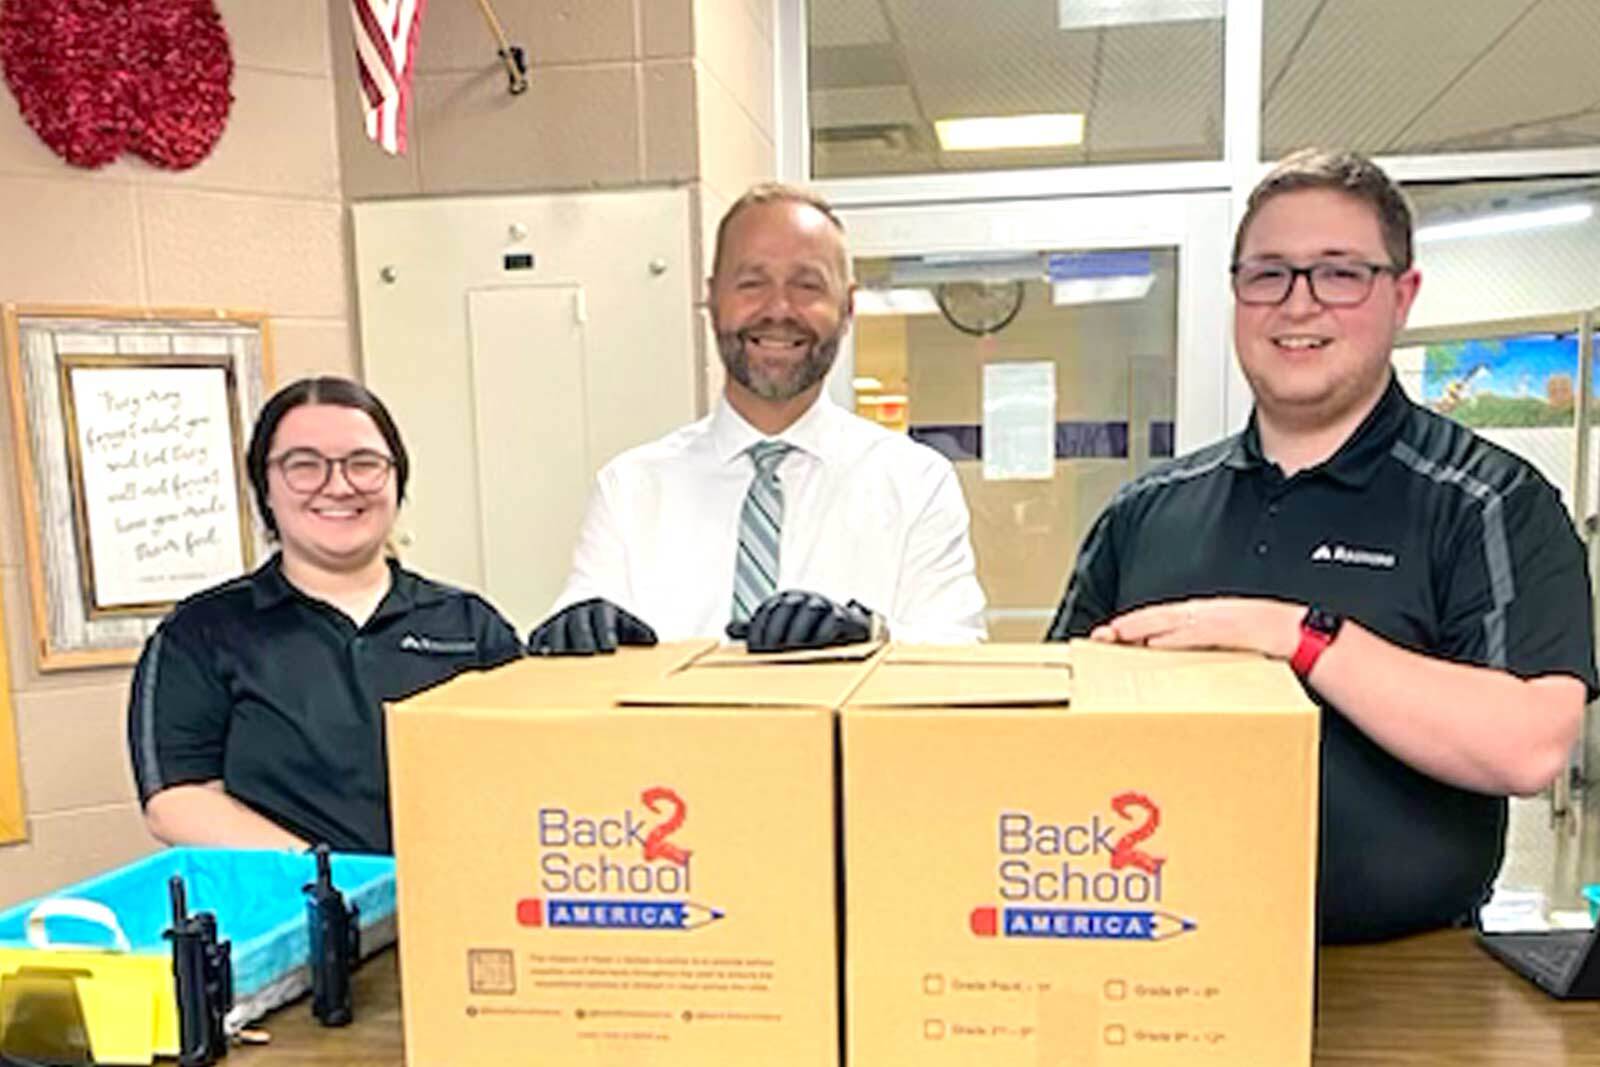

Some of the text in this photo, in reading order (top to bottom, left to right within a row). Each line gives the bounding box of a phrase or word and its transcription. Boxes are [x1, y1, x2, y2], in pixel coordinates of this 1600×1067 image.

[538, 786, 694, 866] Back 2
[999, 791, 1167, 875] Back 2
[540, 851, 692, 895] School
[999, 859, 1164, 903] School
[552, 905, 679, 926] AMERICA
[1009, 914, 1146, 937] AMERICA
